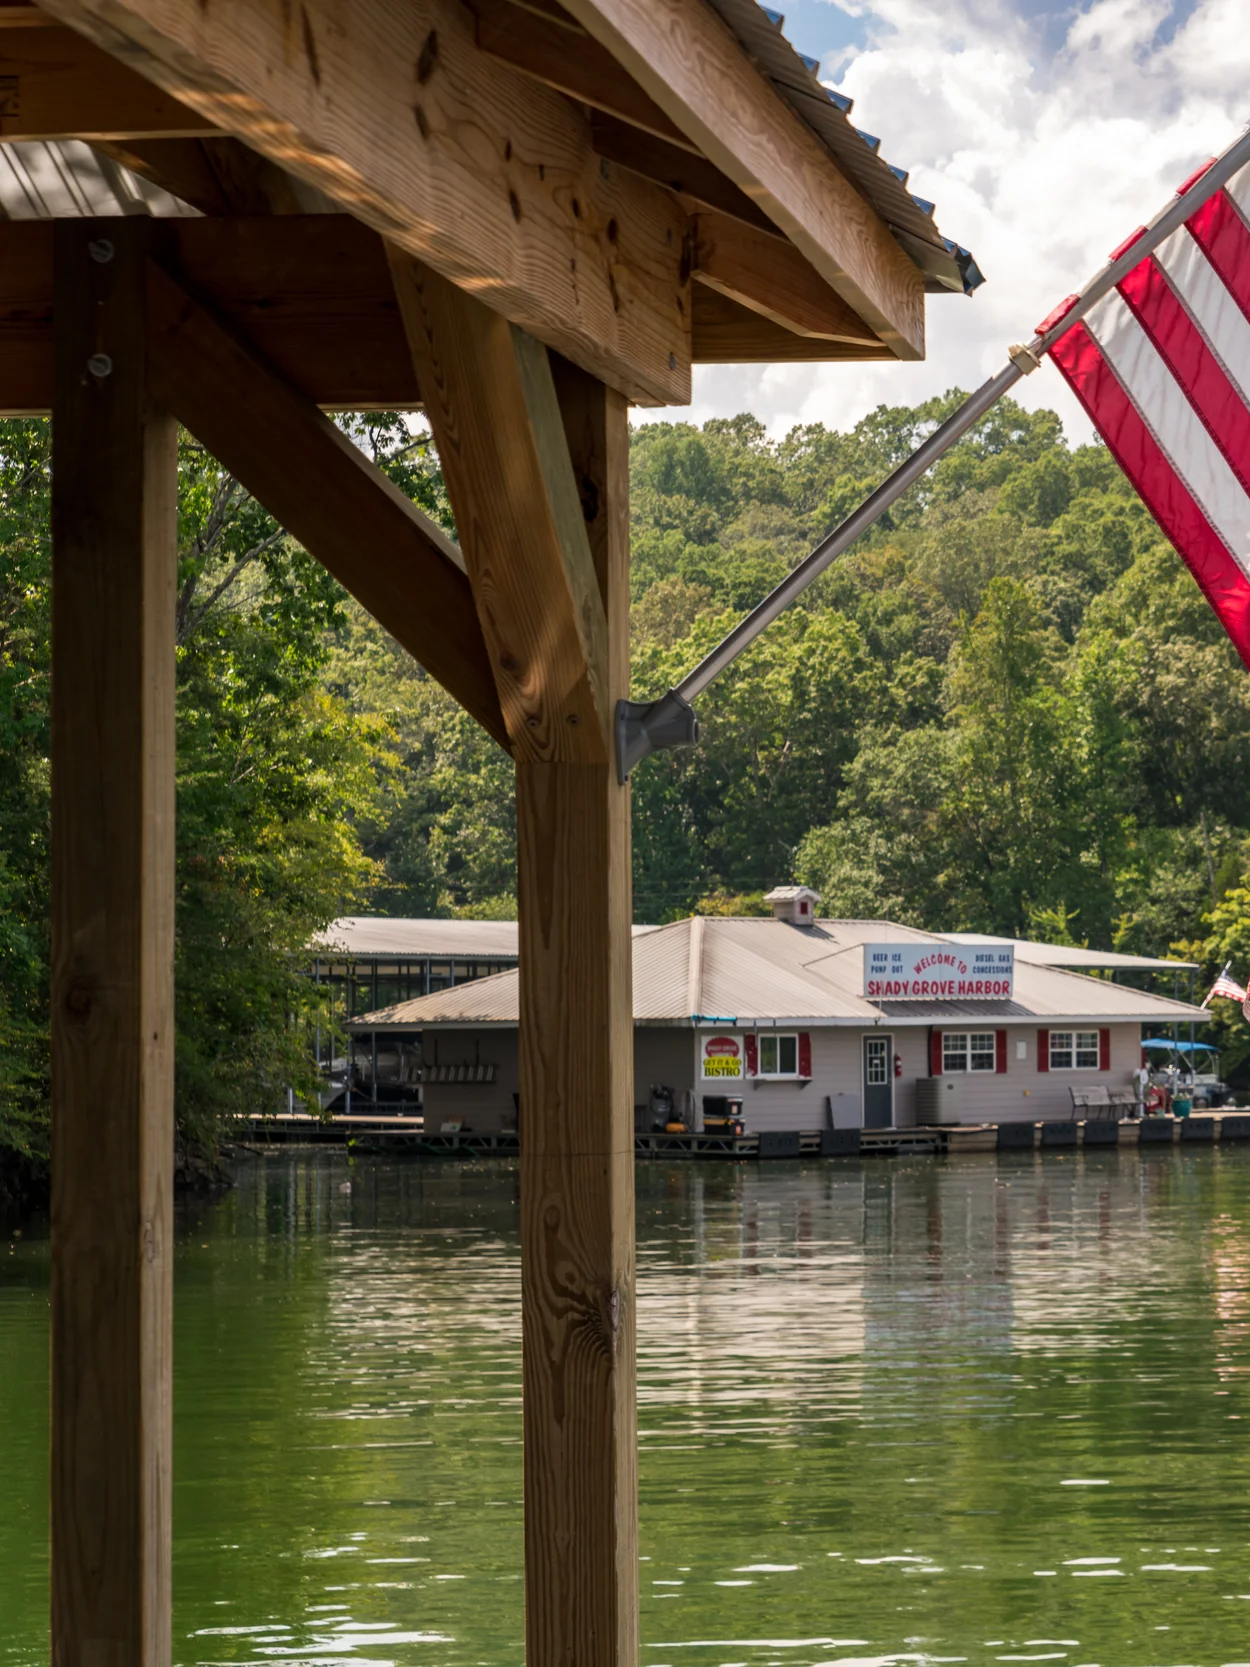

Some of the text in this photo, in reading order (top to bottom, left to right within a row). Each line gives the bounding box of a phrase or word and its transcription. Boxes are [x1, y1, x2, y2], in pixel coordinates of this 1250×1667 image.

[873, 953, 902, 962] BEER ICE
[976, 954, 1010, 962] DIESEL GAS
[913, 953, 967, 975] WELCOME TO
[871, 965, 904, 974] PUMP OUT
[973, 966, 1013, 974] CONCESSIONS
[868, 980, 1010, 995] SHADY GROVE HARBOR
[704, 1067, 740, 1076] BISTRO
